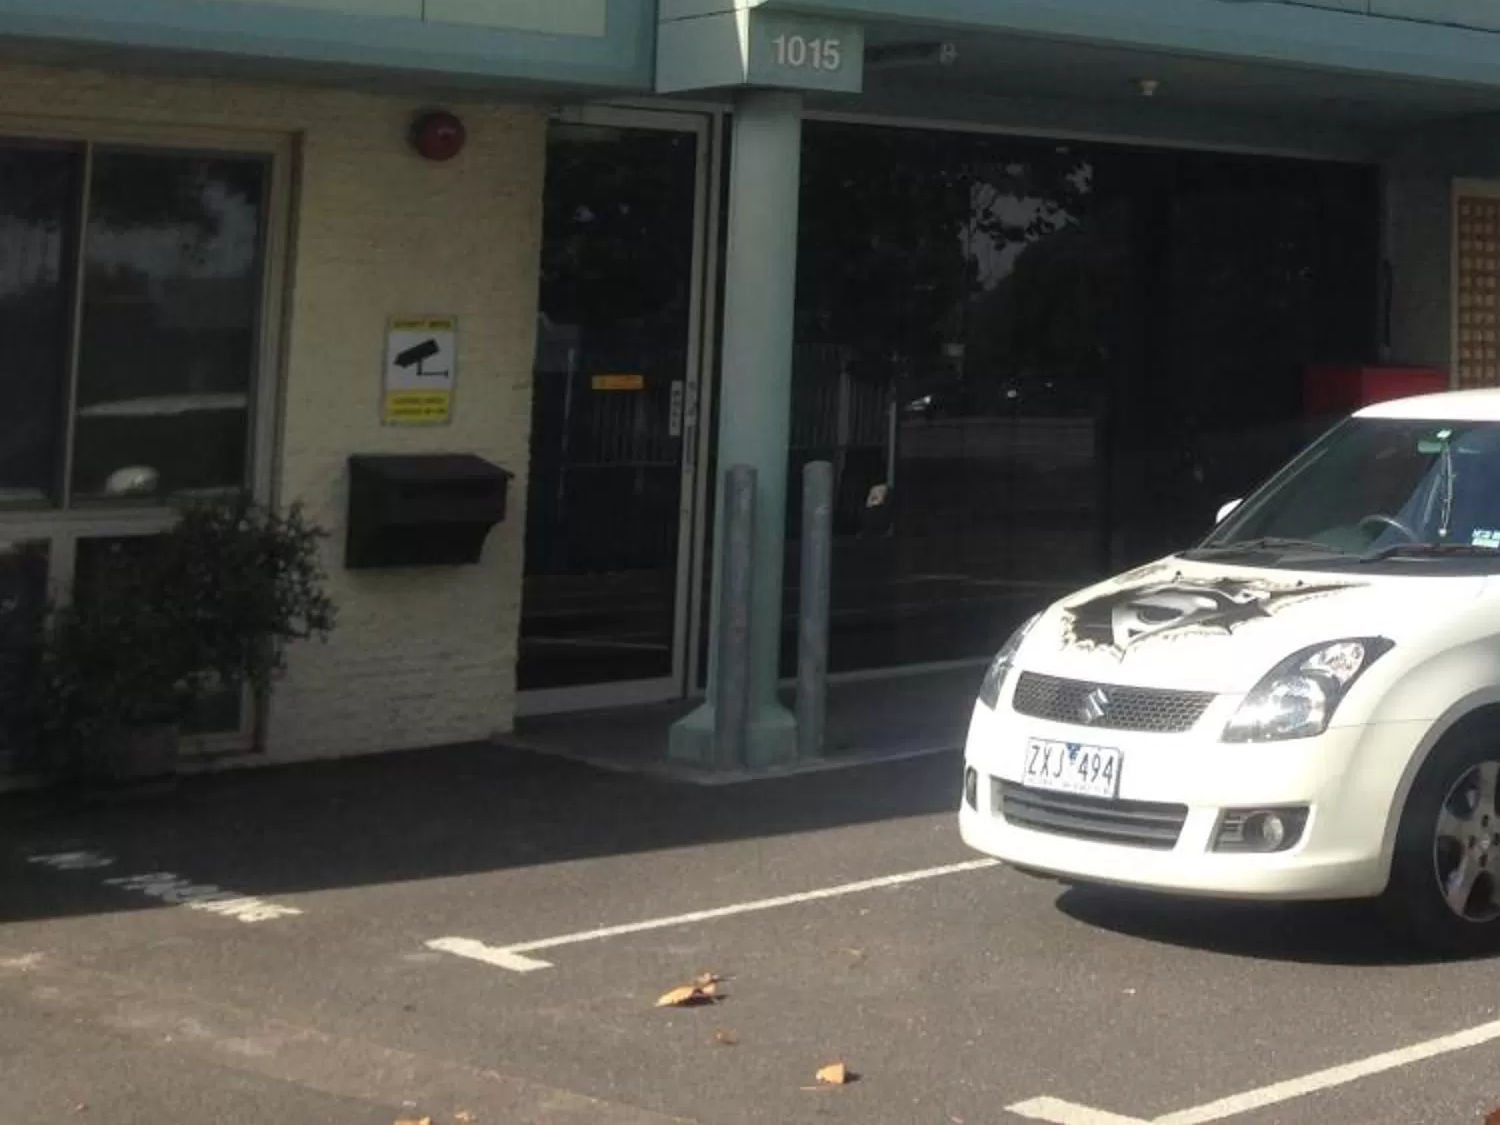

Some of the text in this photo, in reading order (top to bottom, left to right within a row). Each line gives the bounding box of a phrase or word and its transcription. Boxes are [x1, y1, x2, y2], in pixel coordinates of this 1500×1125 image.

[771, 34, 841, 72] 1015
[1027, 743, 1066, 779] ZXJ
[1077, 752, 1115, 787] 494
